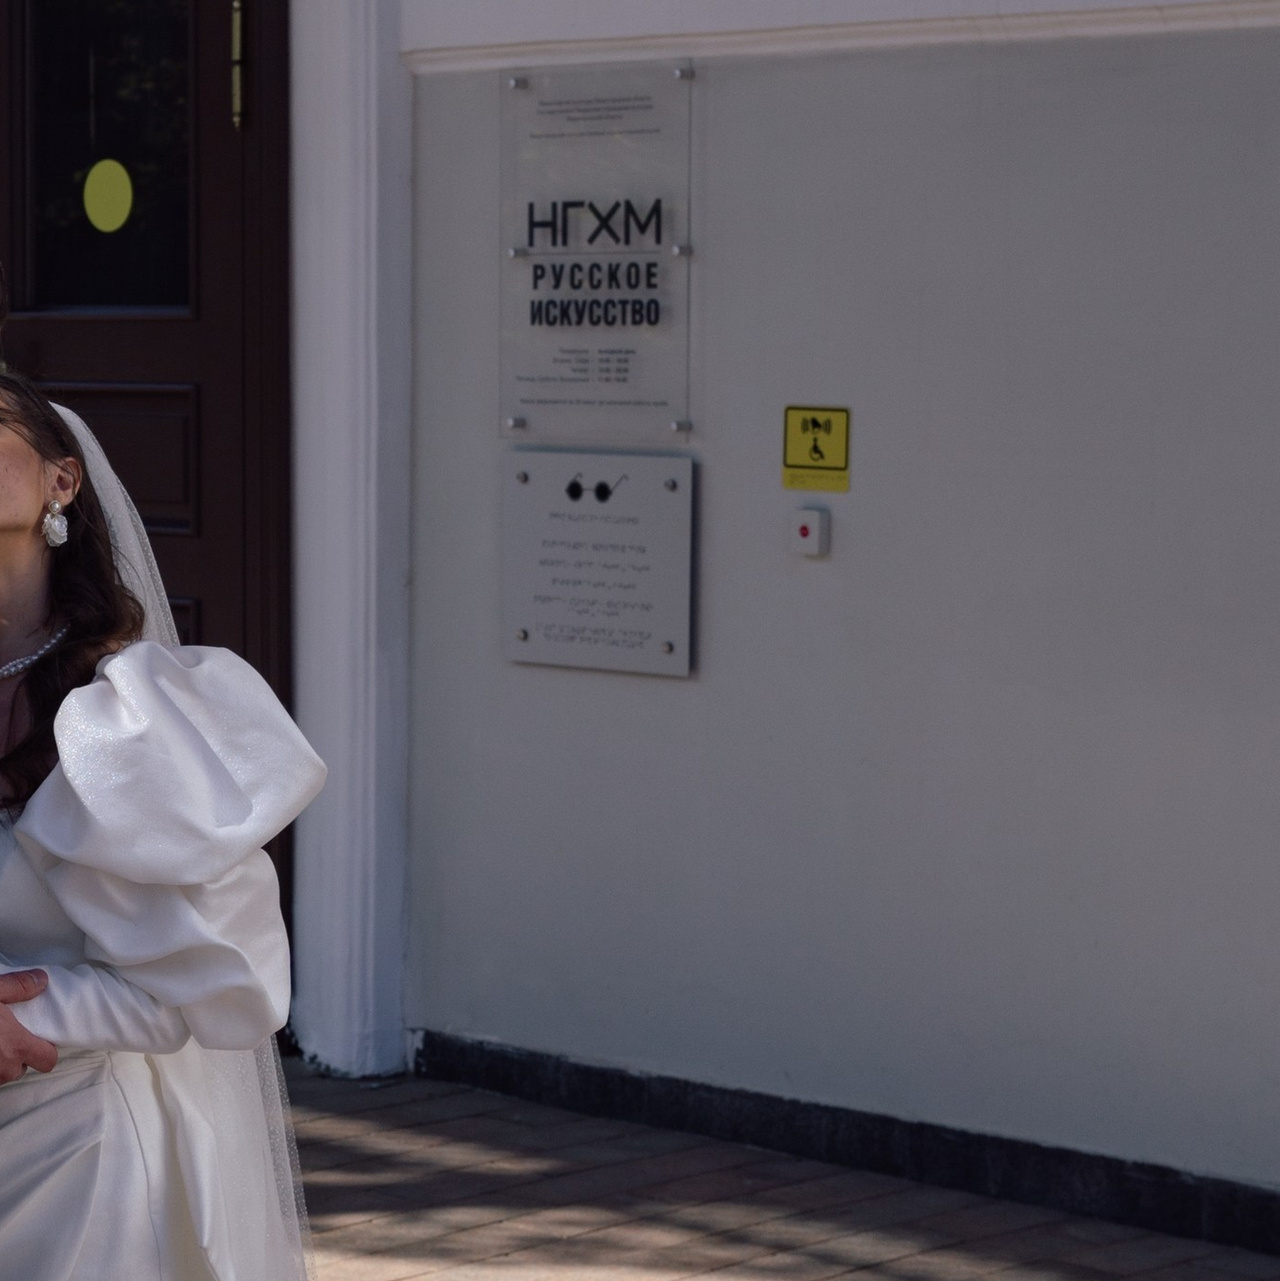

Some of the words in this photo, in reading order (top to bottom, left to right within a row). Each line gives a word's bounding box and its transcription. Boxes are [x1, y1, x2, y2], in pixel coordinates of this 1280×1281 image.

[528, 198, 662, 248] НГХМ
[532, 261, 659, 291] РУССКОЕ
[529, 298, 660, 327] ИСКУССТВО
